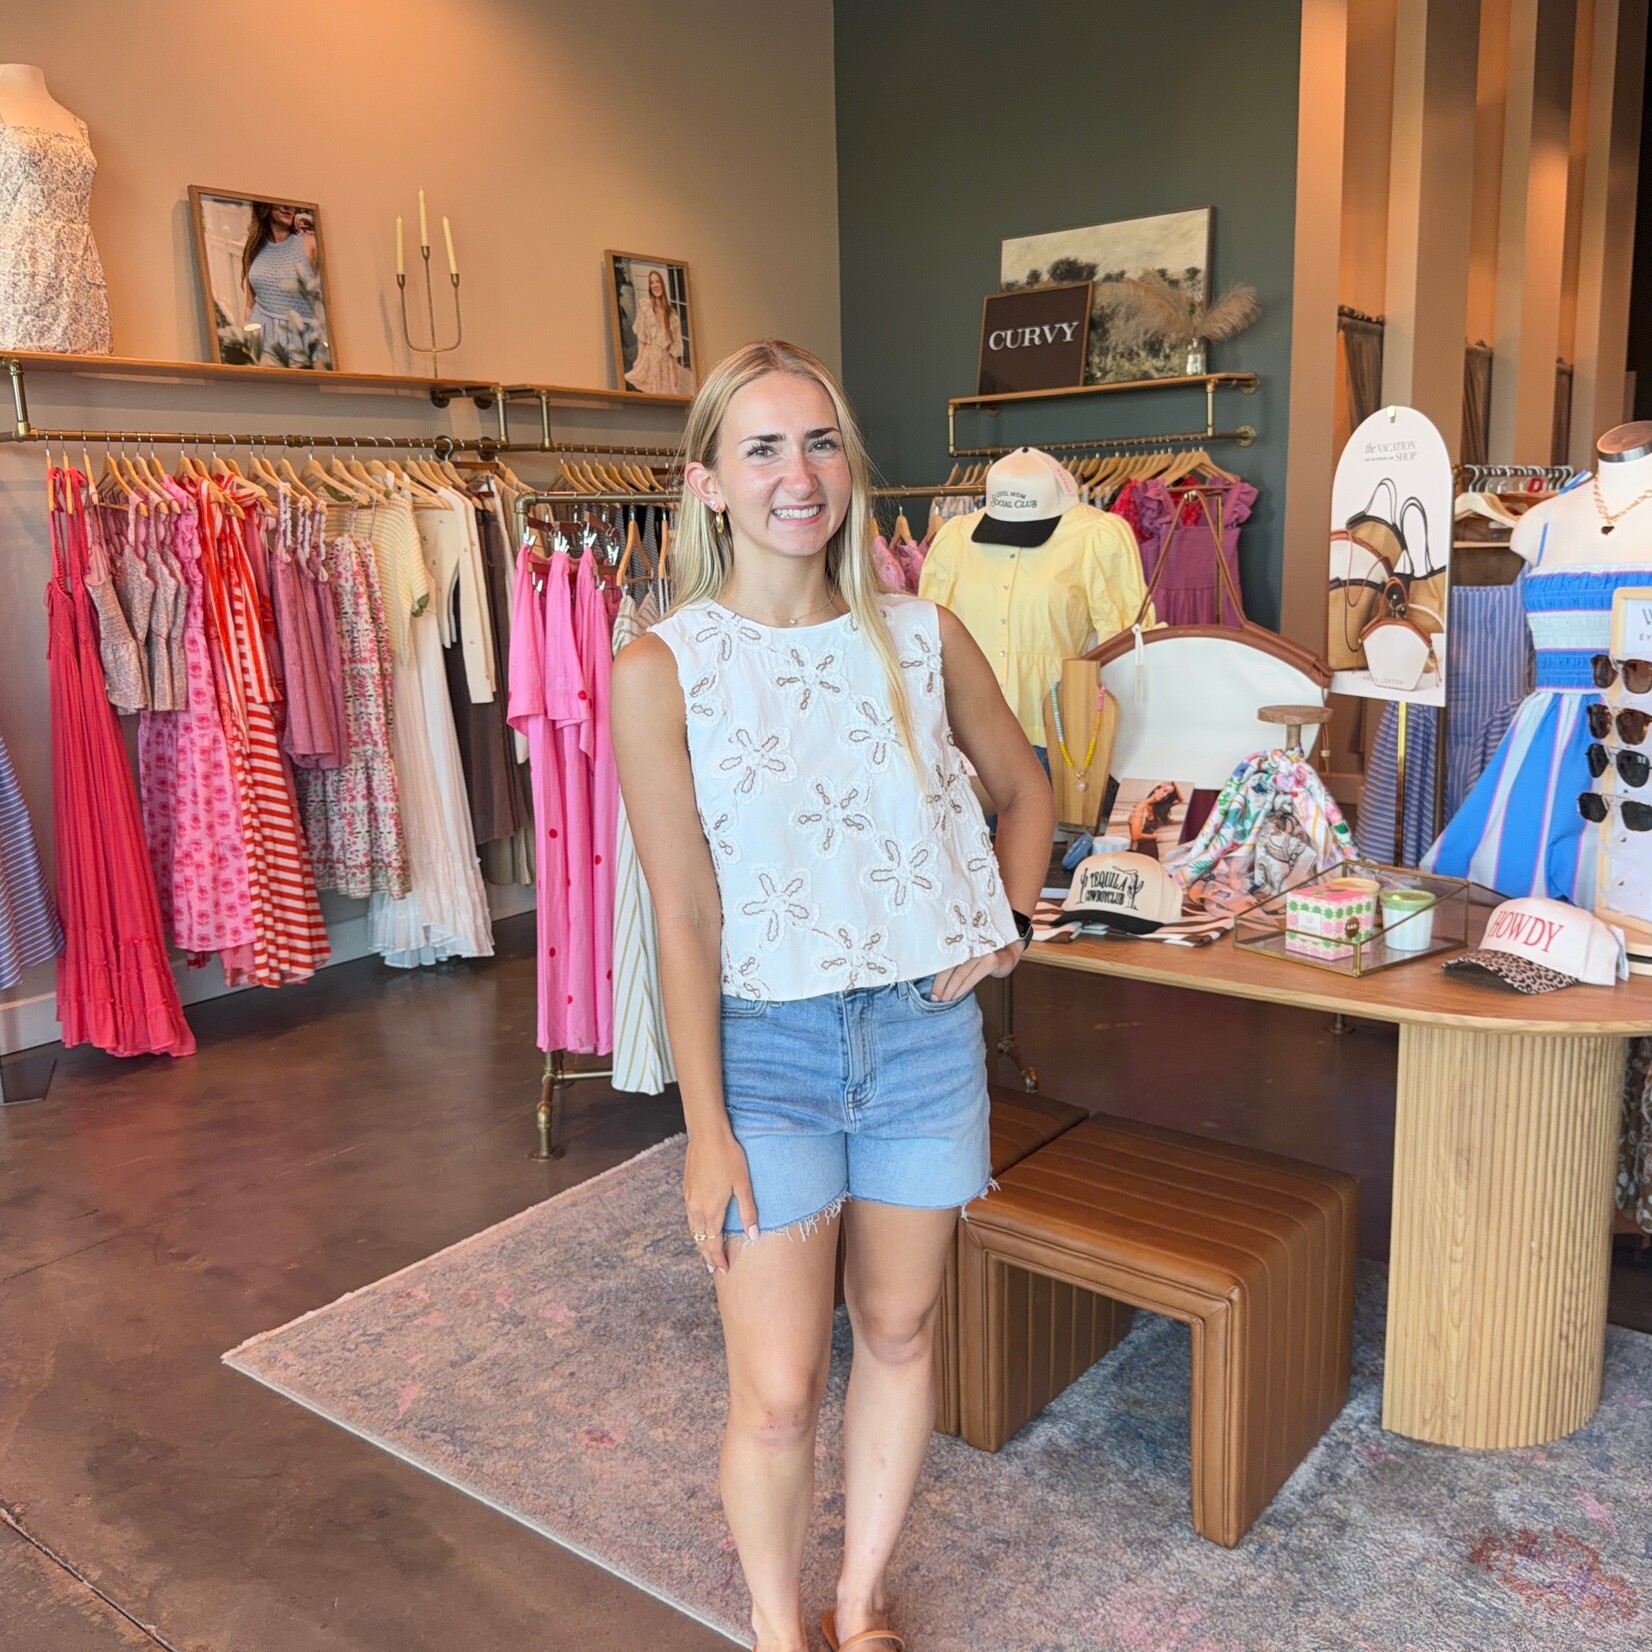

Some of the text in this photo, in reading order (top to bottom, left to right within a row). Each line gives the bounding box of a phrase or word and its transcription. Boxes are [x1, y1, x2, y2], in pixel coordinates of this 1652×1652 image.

[988, 321, 1079, 351] CURVY
[1364, 440, 1416, 454] the VACATION
[1394, 451, 1417, 462] SHOP
[990, 494, 1038, 509] SOCIAL CLUB
[1010, 491, 1027, 499] MOM
[1090, 870, 1128, 891] TEQUILA
[1487, 910, 1565, 953] HOWDY
